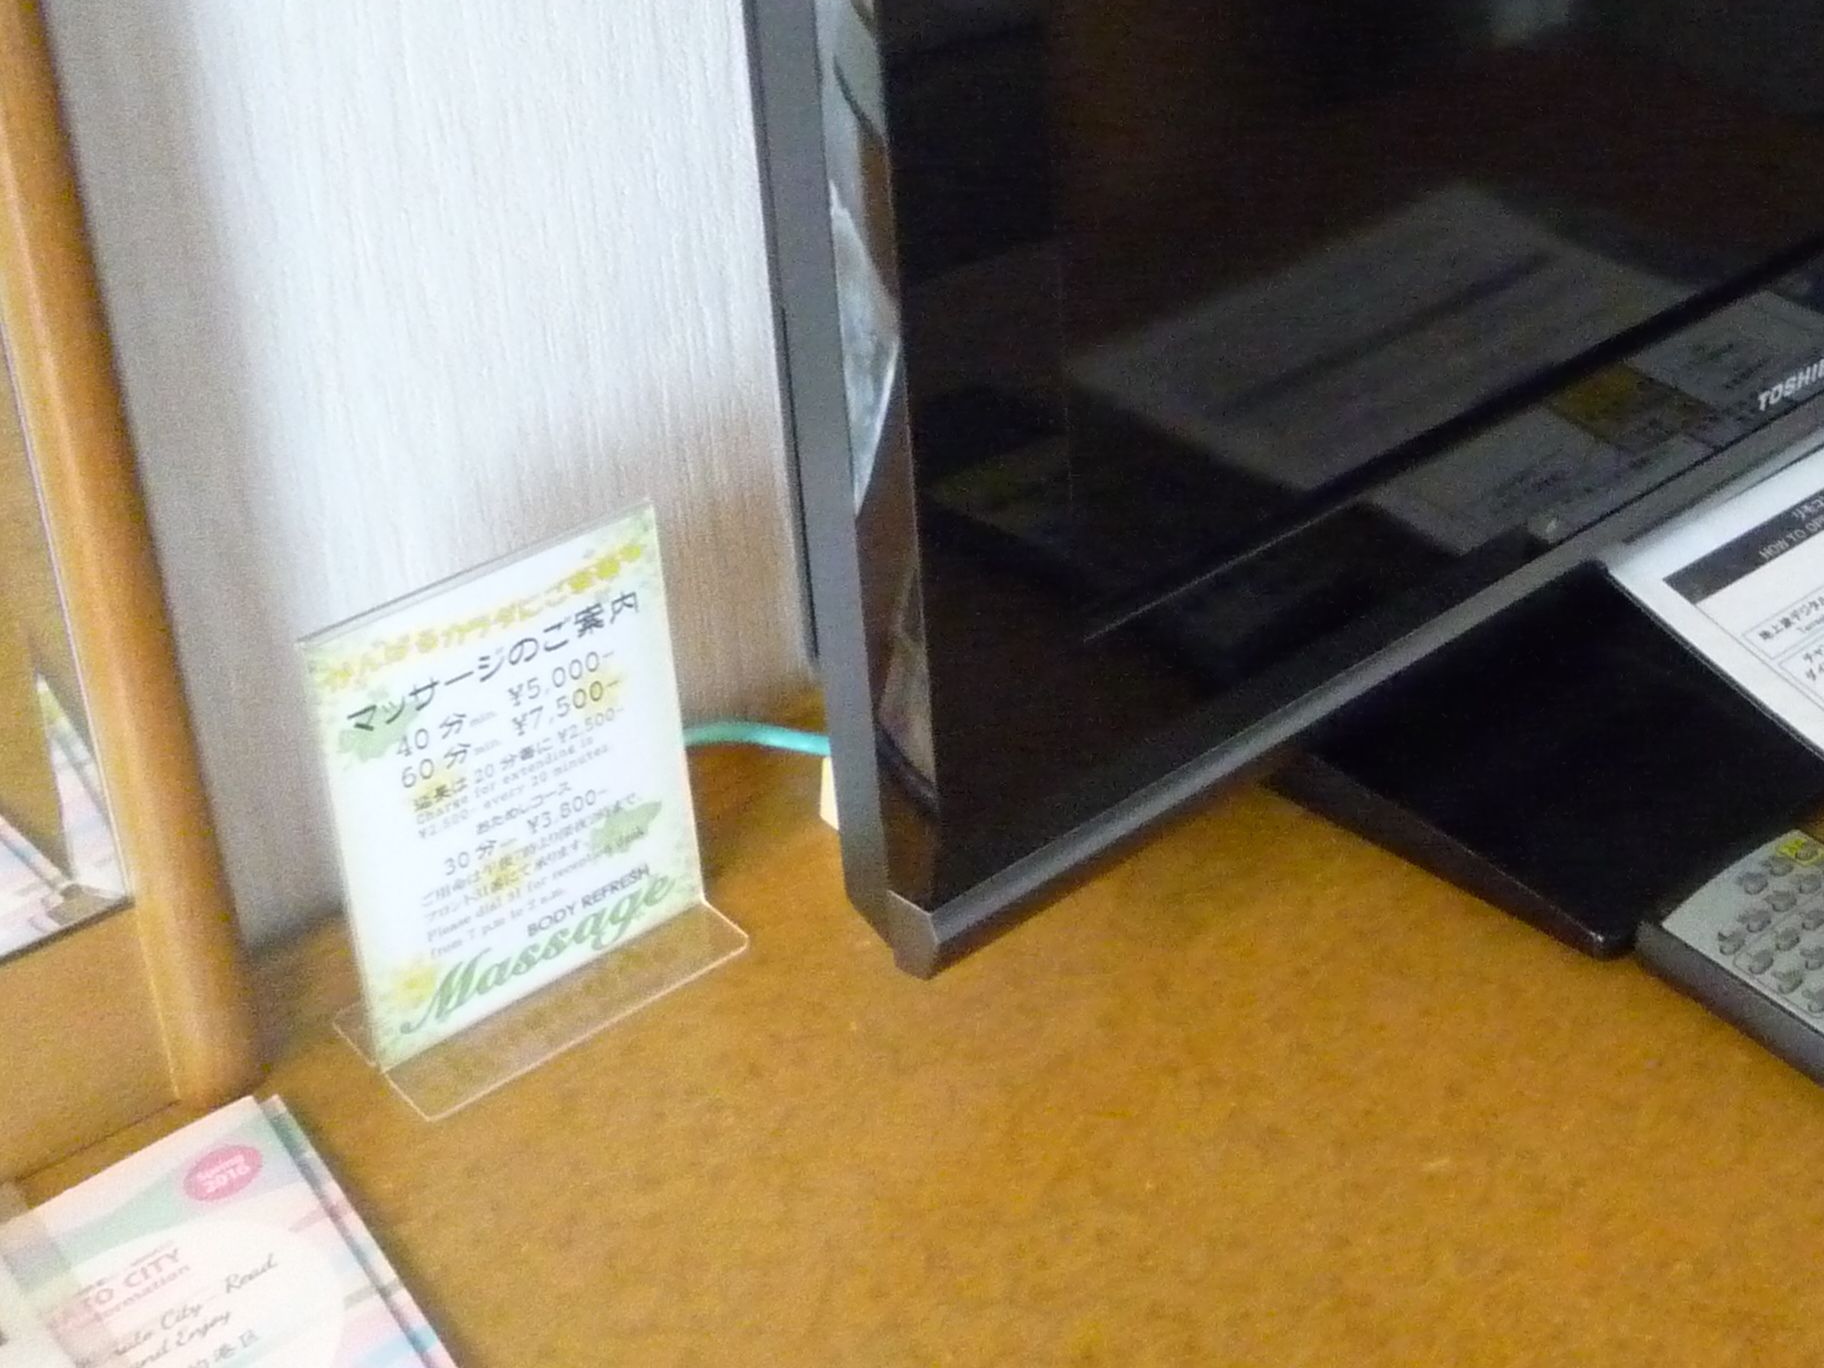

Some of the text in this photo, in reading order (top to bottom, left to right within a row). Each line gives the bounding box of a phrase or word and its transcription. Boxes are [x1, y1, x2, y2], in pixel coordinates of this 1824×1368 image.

[1756, 538, 1791, 560] HOW
[1785, 528, 1809, 542] TO
[346, 591, 639, 732] マッサージのご案内
[393, 724, 430, 760] 40
[399, 754, 435, 790] 60
[443, 848, 471, 877] 30
[526, 860, 650, 939] BODY REFRESH
[402, 872, 674, 1035] Massage
[204, 1162, 252, 1194] 2016
[124, 1247, 180, 1288] CITY
[159, 1302, 203, 1330] City
